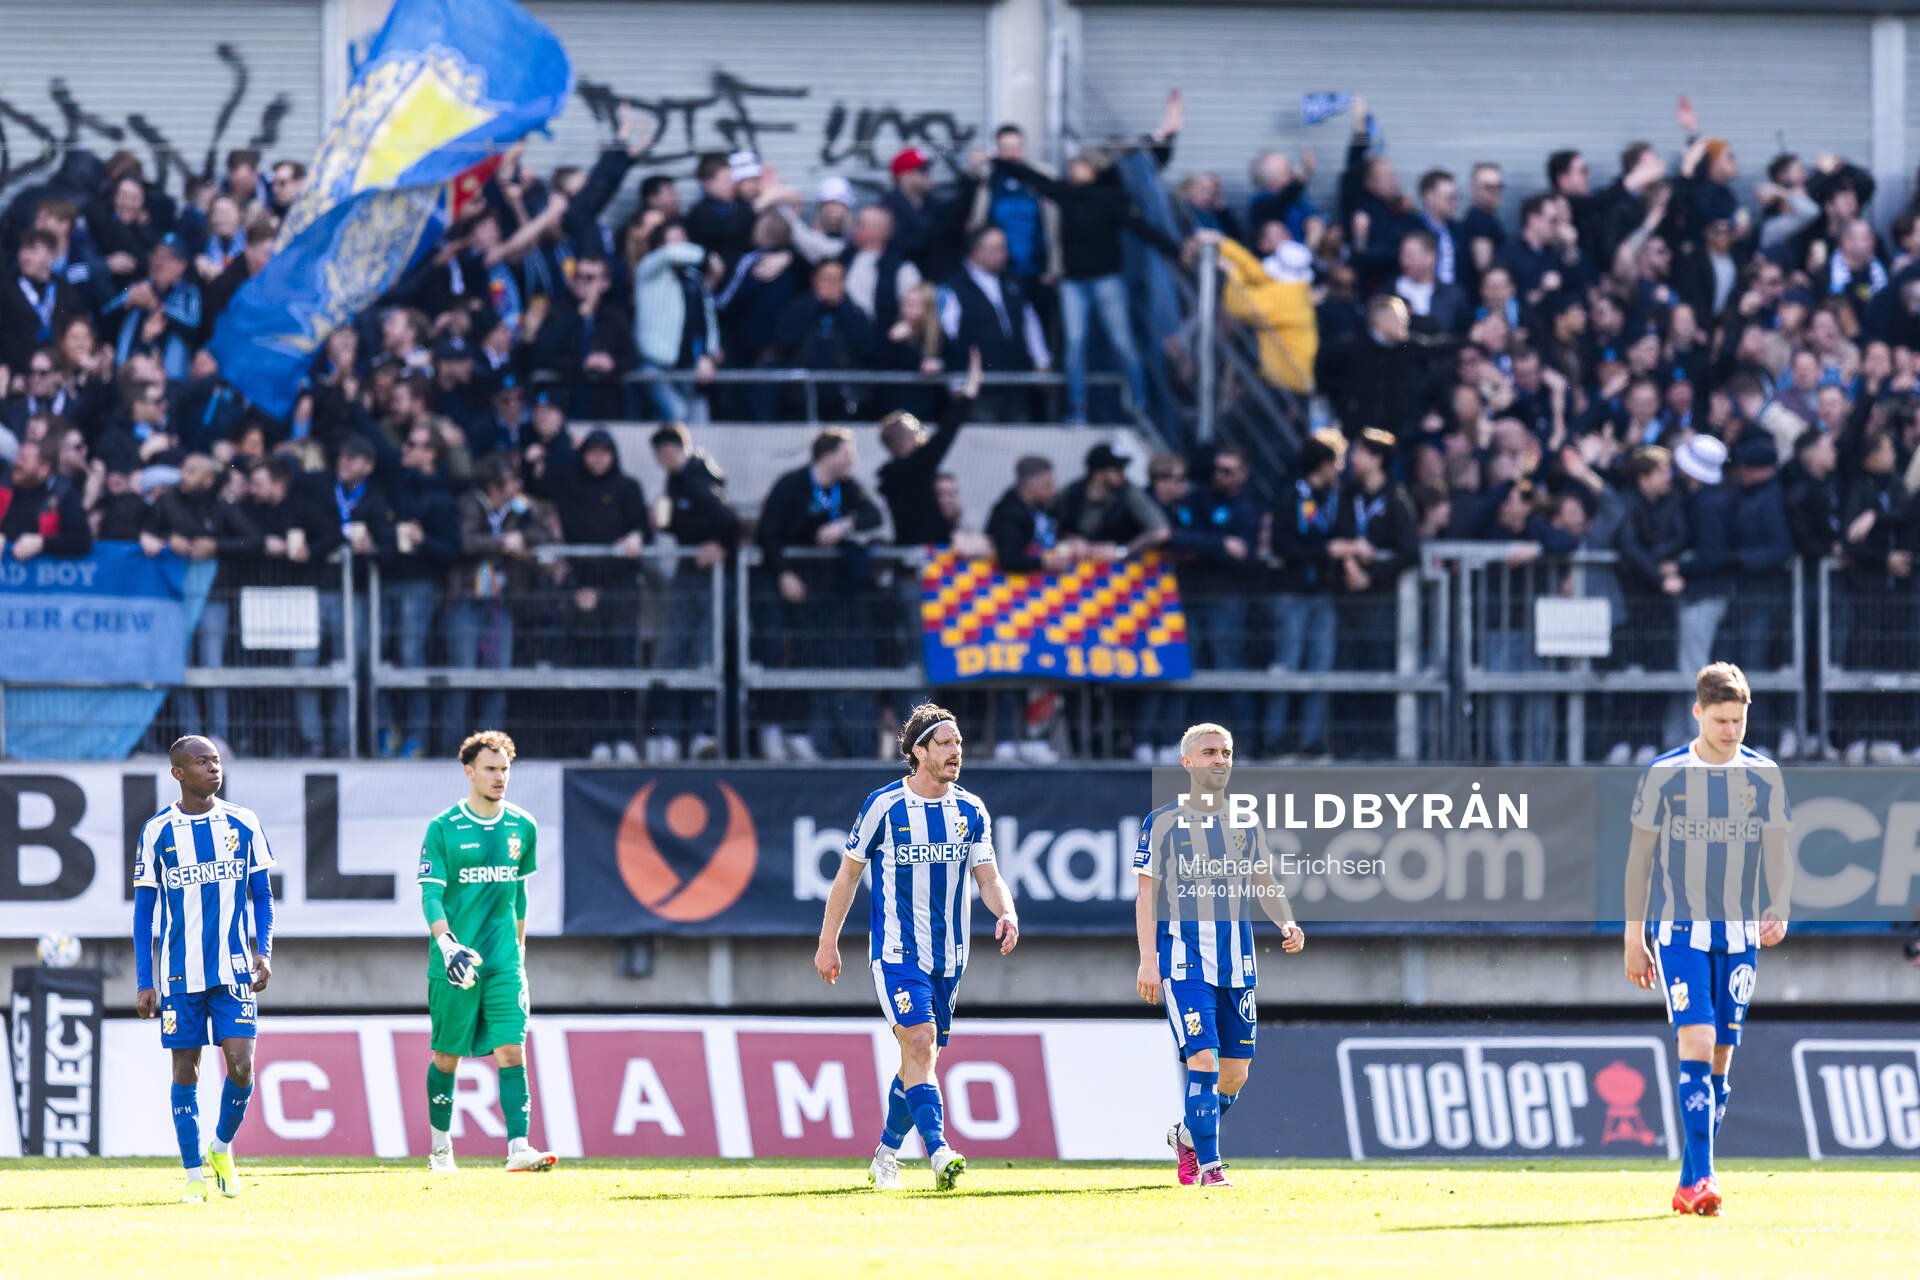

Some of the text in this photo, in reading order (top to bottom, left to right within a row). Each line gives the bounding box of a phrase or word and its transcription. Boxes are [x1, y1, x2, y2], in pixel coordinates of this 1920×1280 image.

[36, 561, 99, 587] BOY
[71, 607, 155, 633] CREW
[954, 642, 1029, 677] DIF
[1065, 646, 1163, 677] 1891
[1670, 815, 1763, 843] SERNEKE
[896, 842, 971, 865] SERNEKE
[167, 858, 245, 889] SERNEKE
[241, 1003, 253, 1018] 30
[260, 1057, 1020, 1140] CRAMO
[1363, 1056, 1588, 1149] weber
[1817, 1062, 1920, 1150] we
